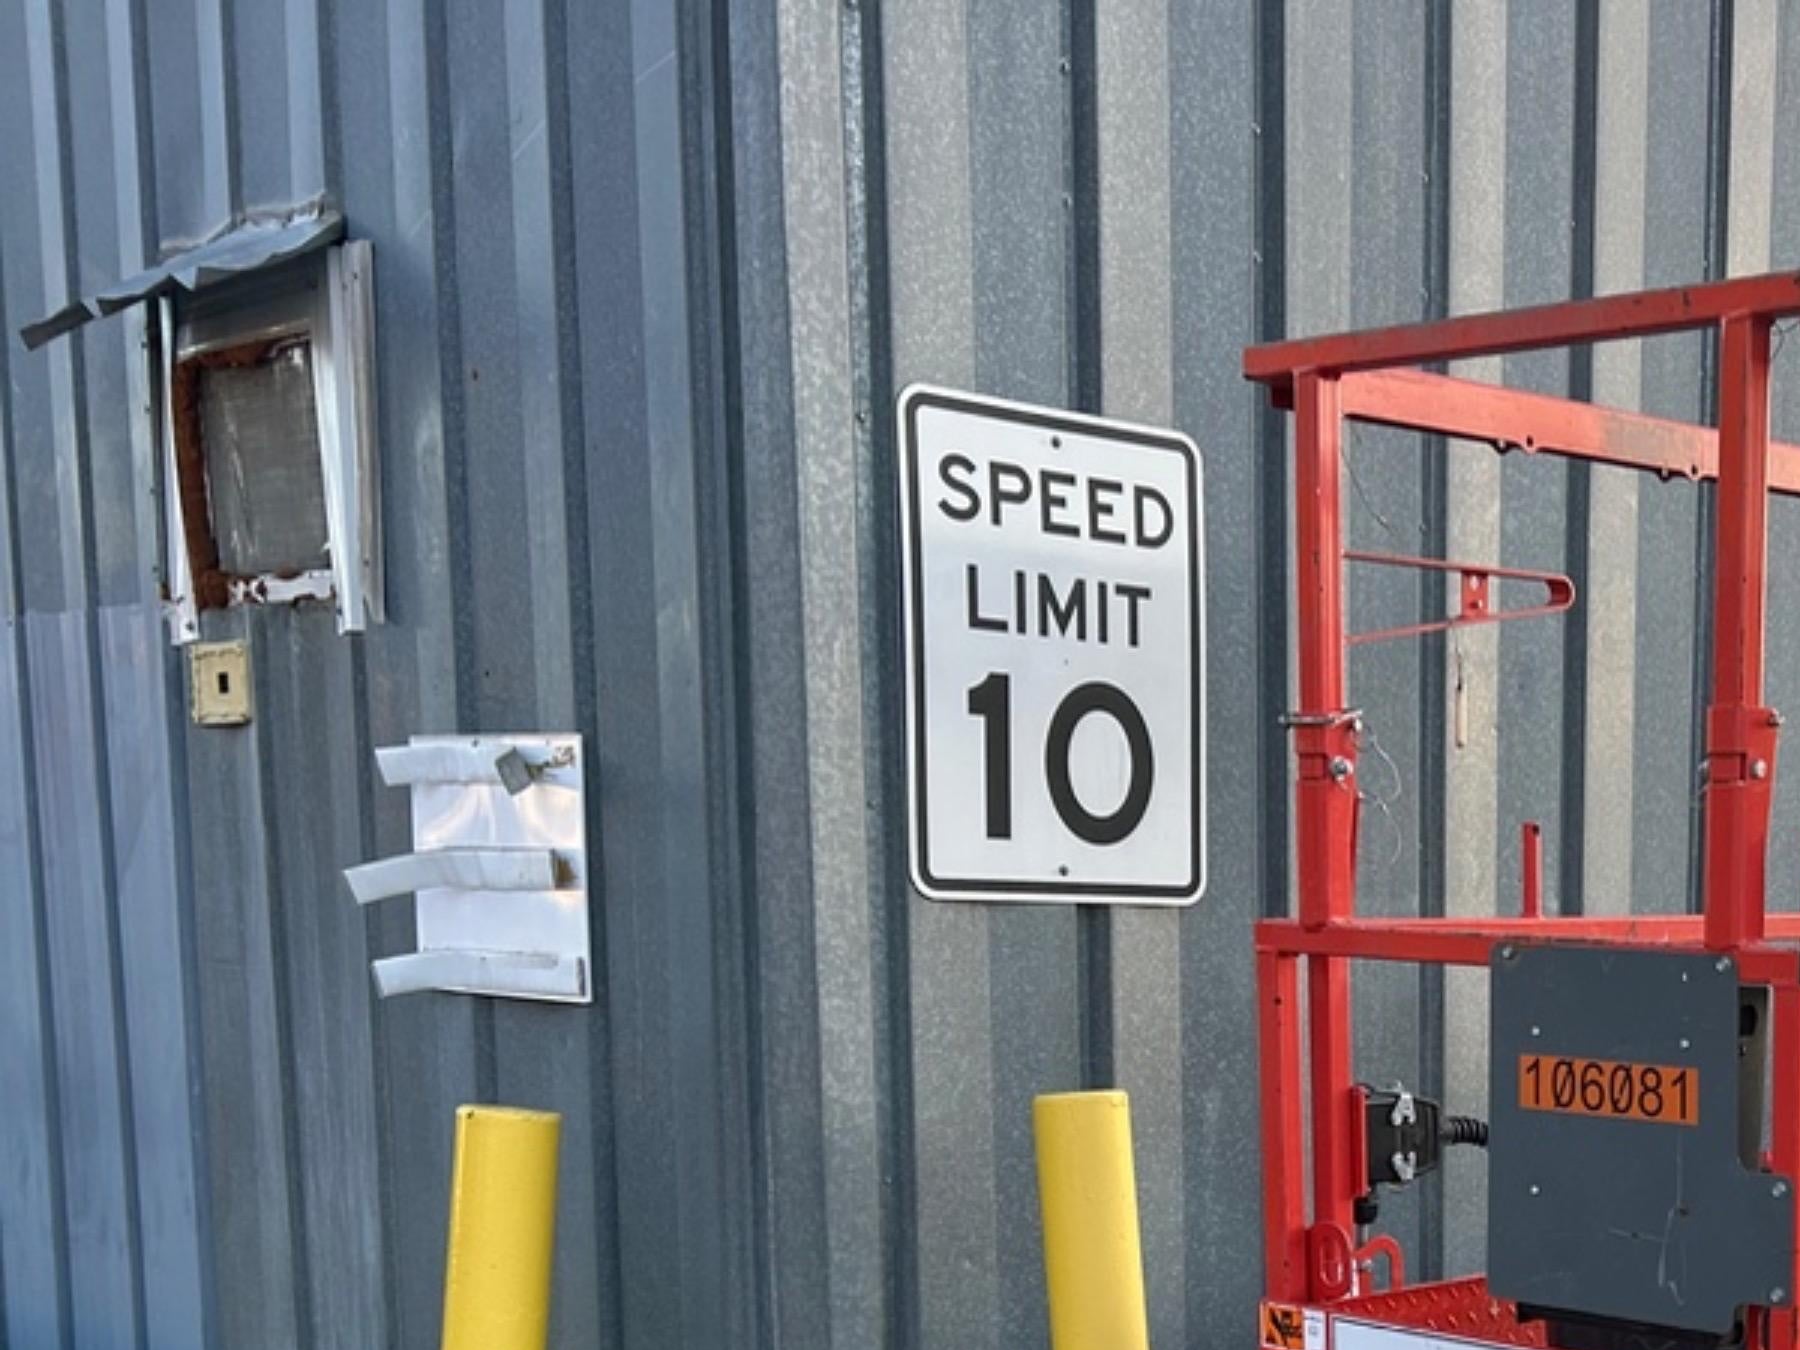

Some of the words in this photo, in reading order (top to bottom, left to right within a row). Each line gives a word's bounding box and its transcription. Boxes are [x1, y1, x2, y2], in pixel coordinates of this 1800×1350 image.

[938, 453, 1173, 549] SPEED
[967, 564, 1151, 647] LIMIT
[967, 672, 1154, 846] 10
[1525, 1057, 1688, 1120] 106081
